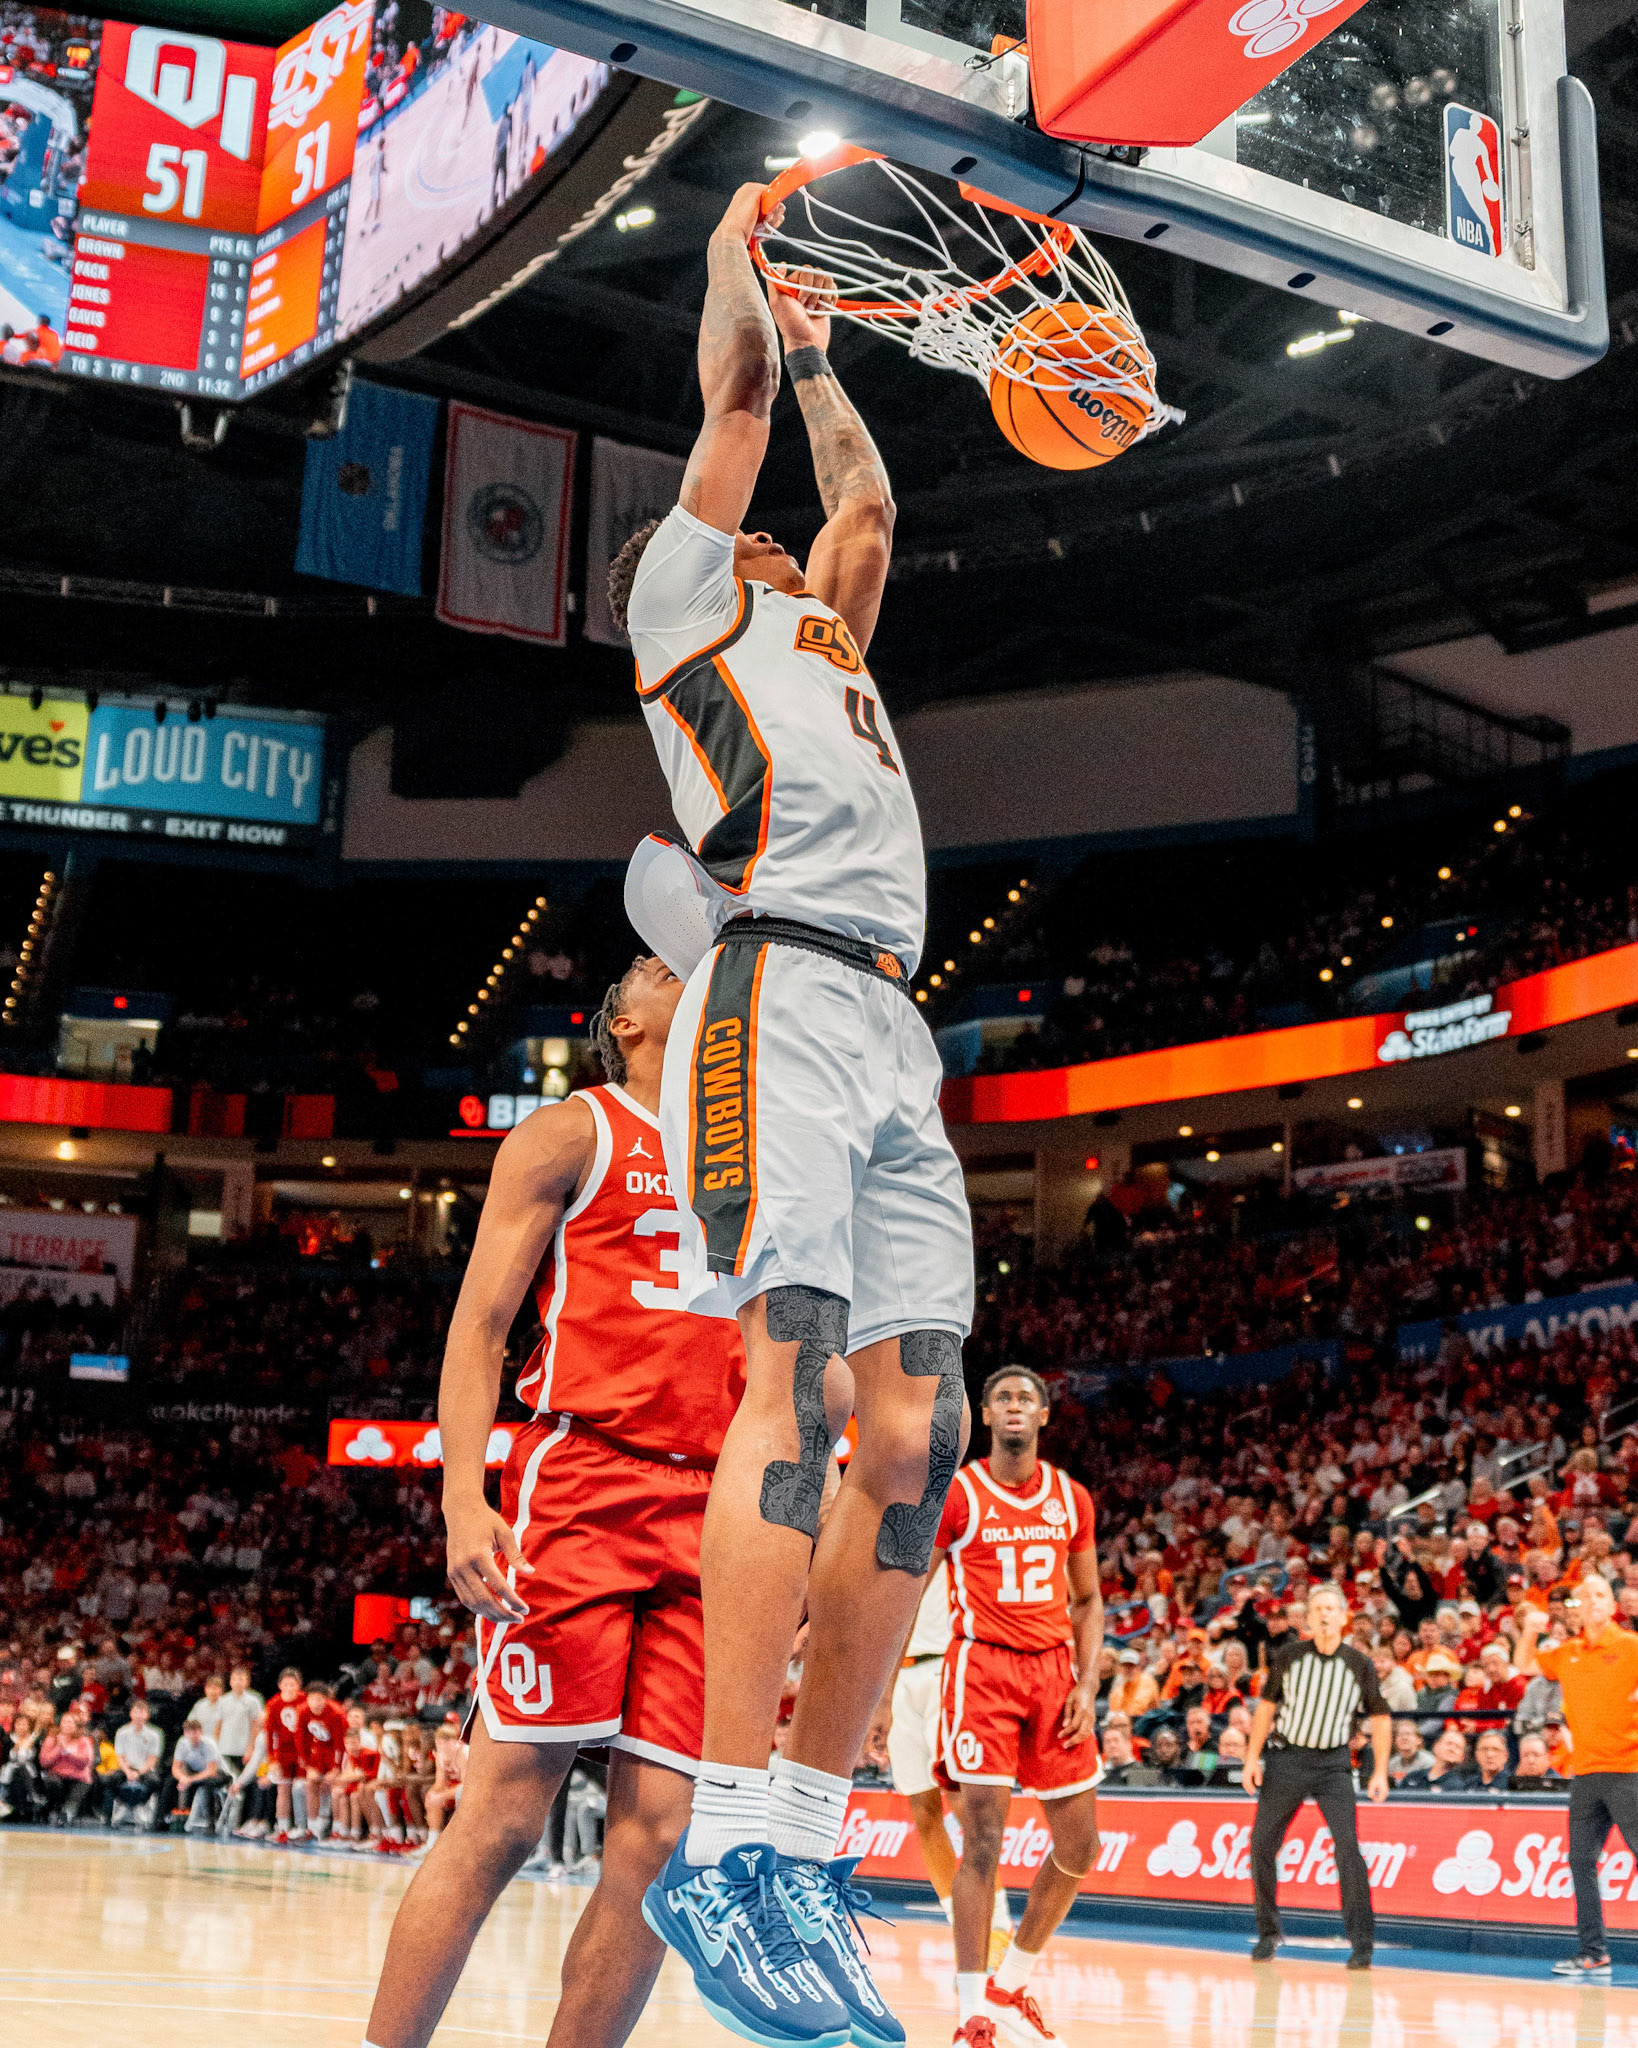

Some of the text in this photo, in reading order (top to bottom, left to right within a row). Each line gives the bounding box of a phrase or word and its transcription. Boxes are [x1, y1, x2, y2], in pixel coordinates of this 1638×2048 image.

[142, 143, 207, 219] 51
[290, 120, 330, 205] 51
[77, 236, 126, 260] BROWN
[82, 214, 253, 258] PLAYER PTS FL
[1456, 215, 1485, 248] NBA
[74, 260, 111, 281] PACK
[71, 283, 112, 305] JONES
[65, 330, 99, 350] REID
[159, 369, 189, 389] 2ND
[197, 376, 234, 398] 11:32
[1067, 387, 1140, 449] Wilson
[844, 685, 901, 777] 4
[93, 725, 207, 792] LOUD
[221, 730, 313, 809] CITY
[9, 803, 129, 832] THUNDER
[165, 817, 225, 840] EXIT
[227, 823, 287, 847] NOW
[702, 1016, 745, 1192] COWBOYS
[981, 1525, 1067, 1543] OKLAHOMA
[995, 1544, 1057, 1603] 12
[499, 1642, 554, 1715] OU
[956, 1731, 984, 1771] OU
